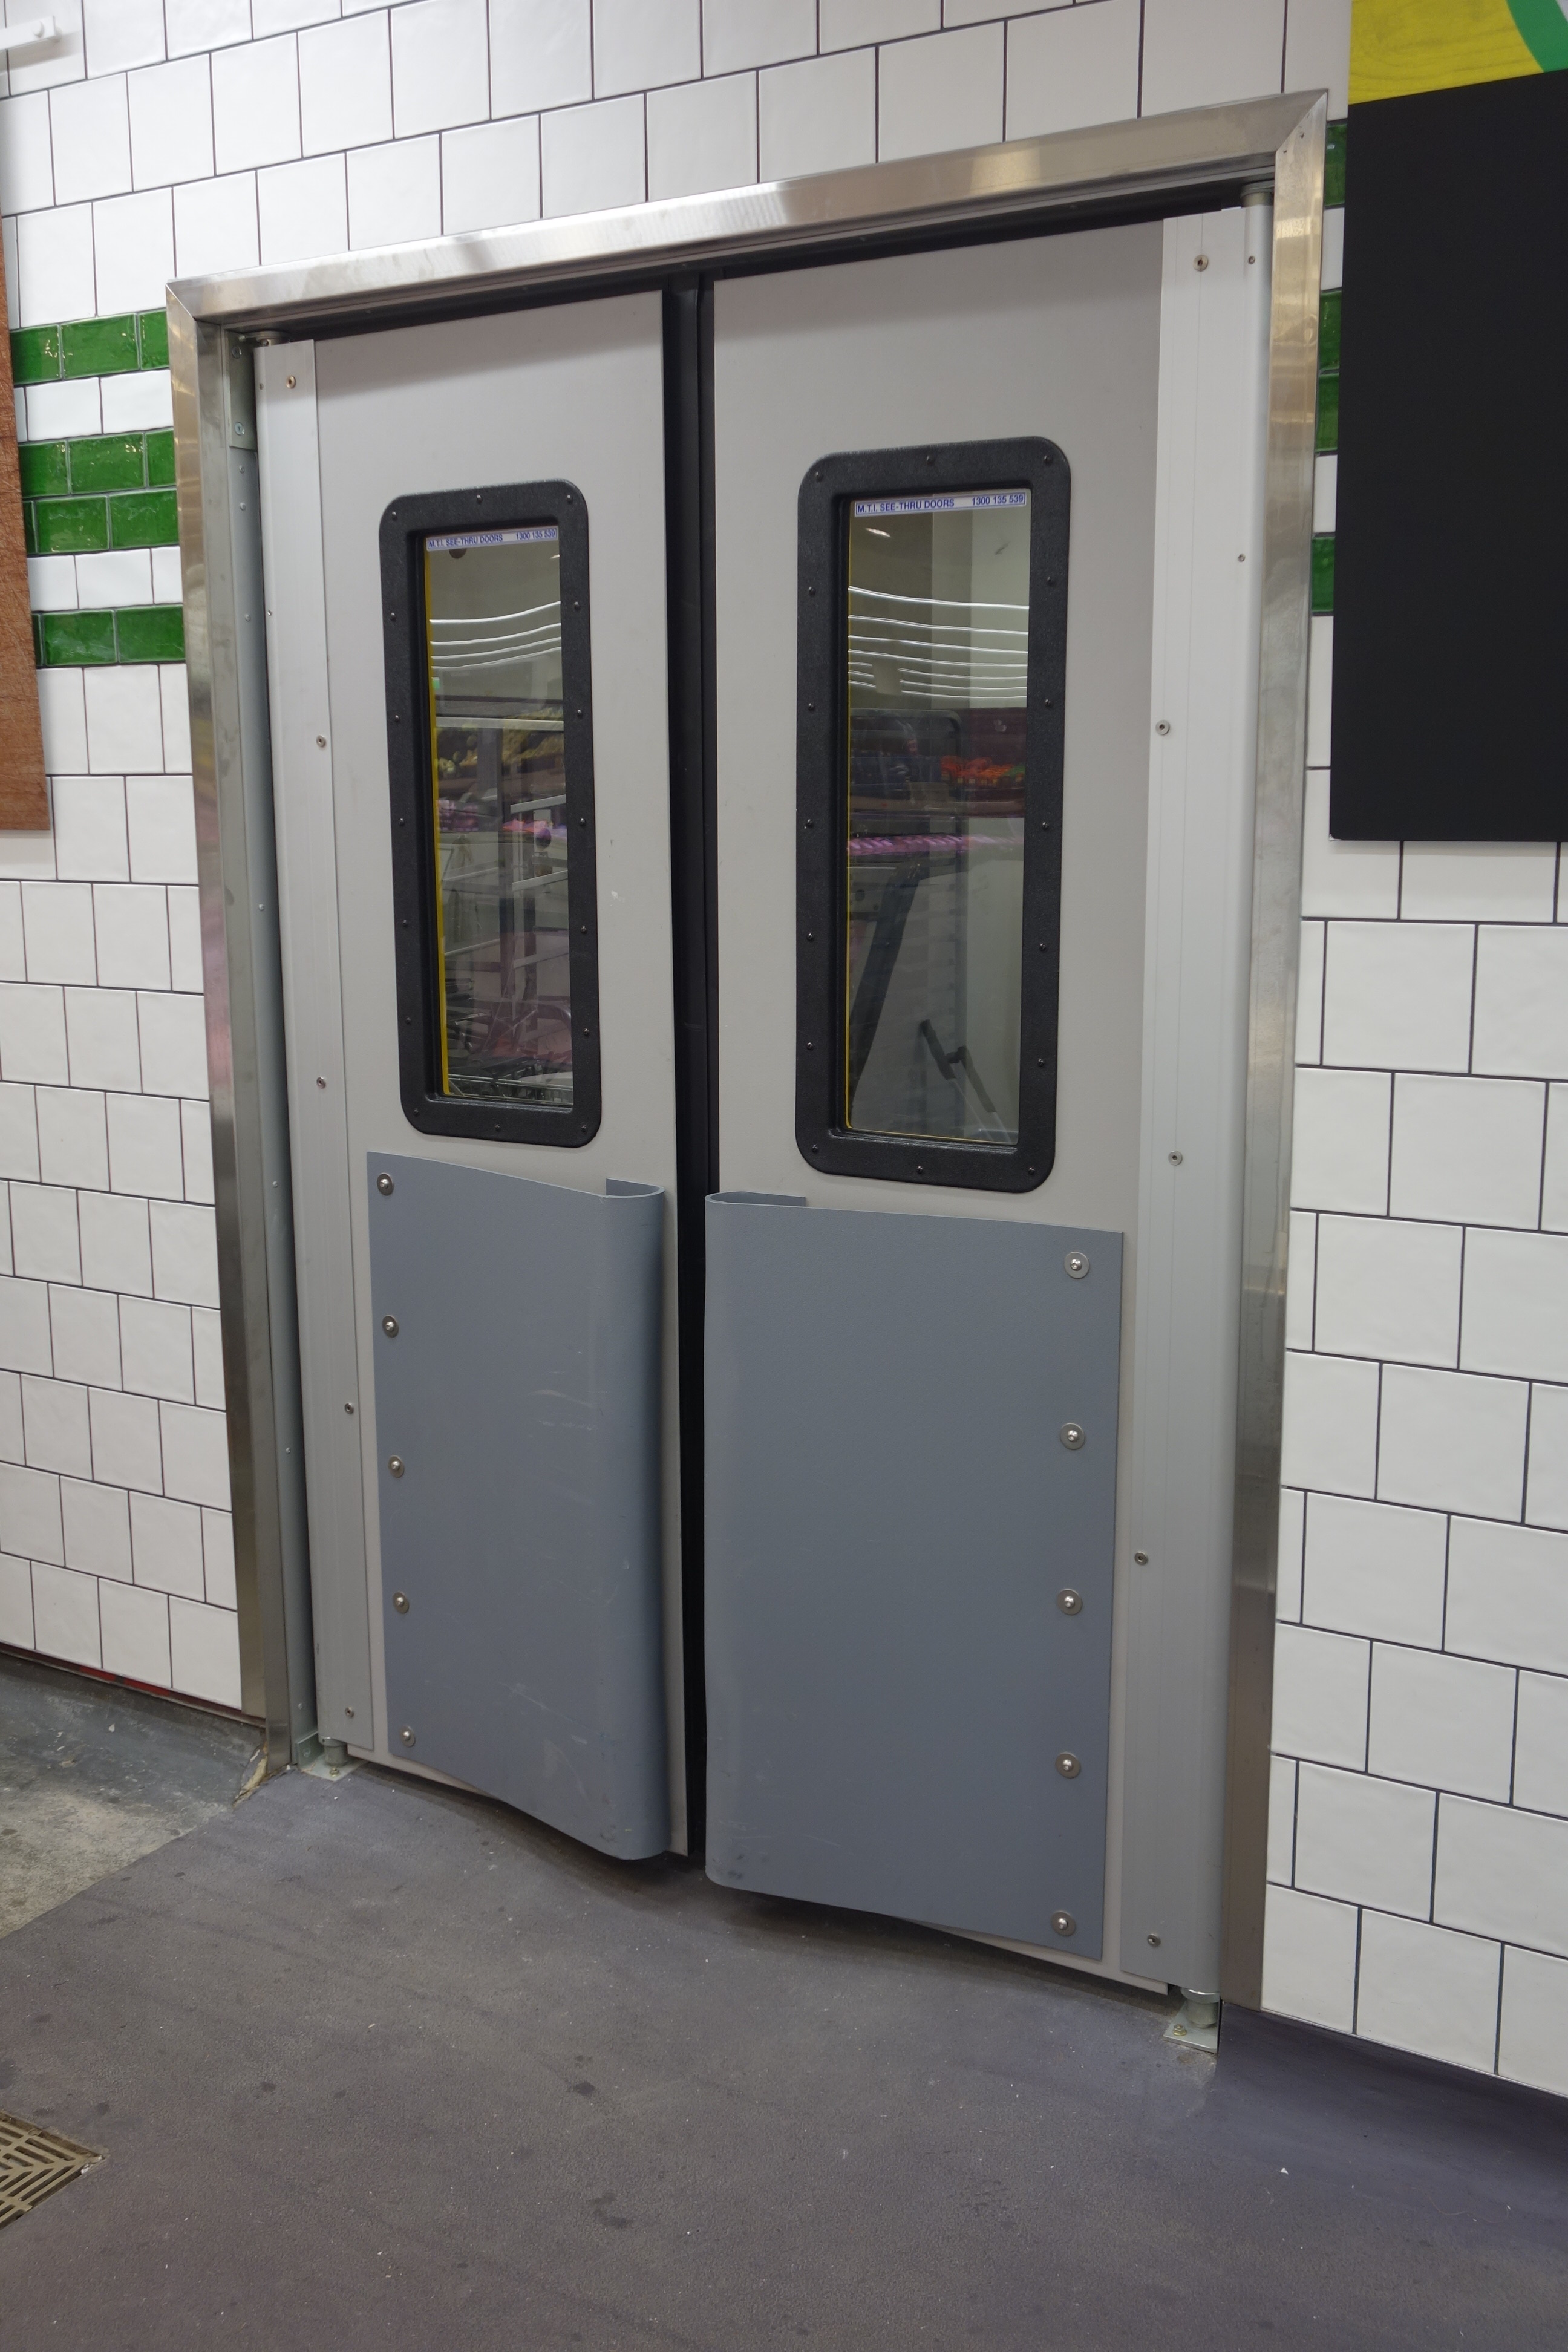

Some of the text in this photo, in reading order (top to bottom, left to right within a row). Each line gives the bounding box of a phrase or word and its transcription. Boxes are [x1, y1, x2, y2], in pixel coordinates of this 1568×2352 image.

[857, 494, 1024, 512] M.T.I. SEE-THRU DOORS 1300 135 539
[429, 538, 443, 547] M.T.I.
[446, 536, 478, 546] SEE-THRU
[480, 534, 503, 543] DOORS
[516, 532, 530, 540] 1300
[544, 529, 555, 537] 539
